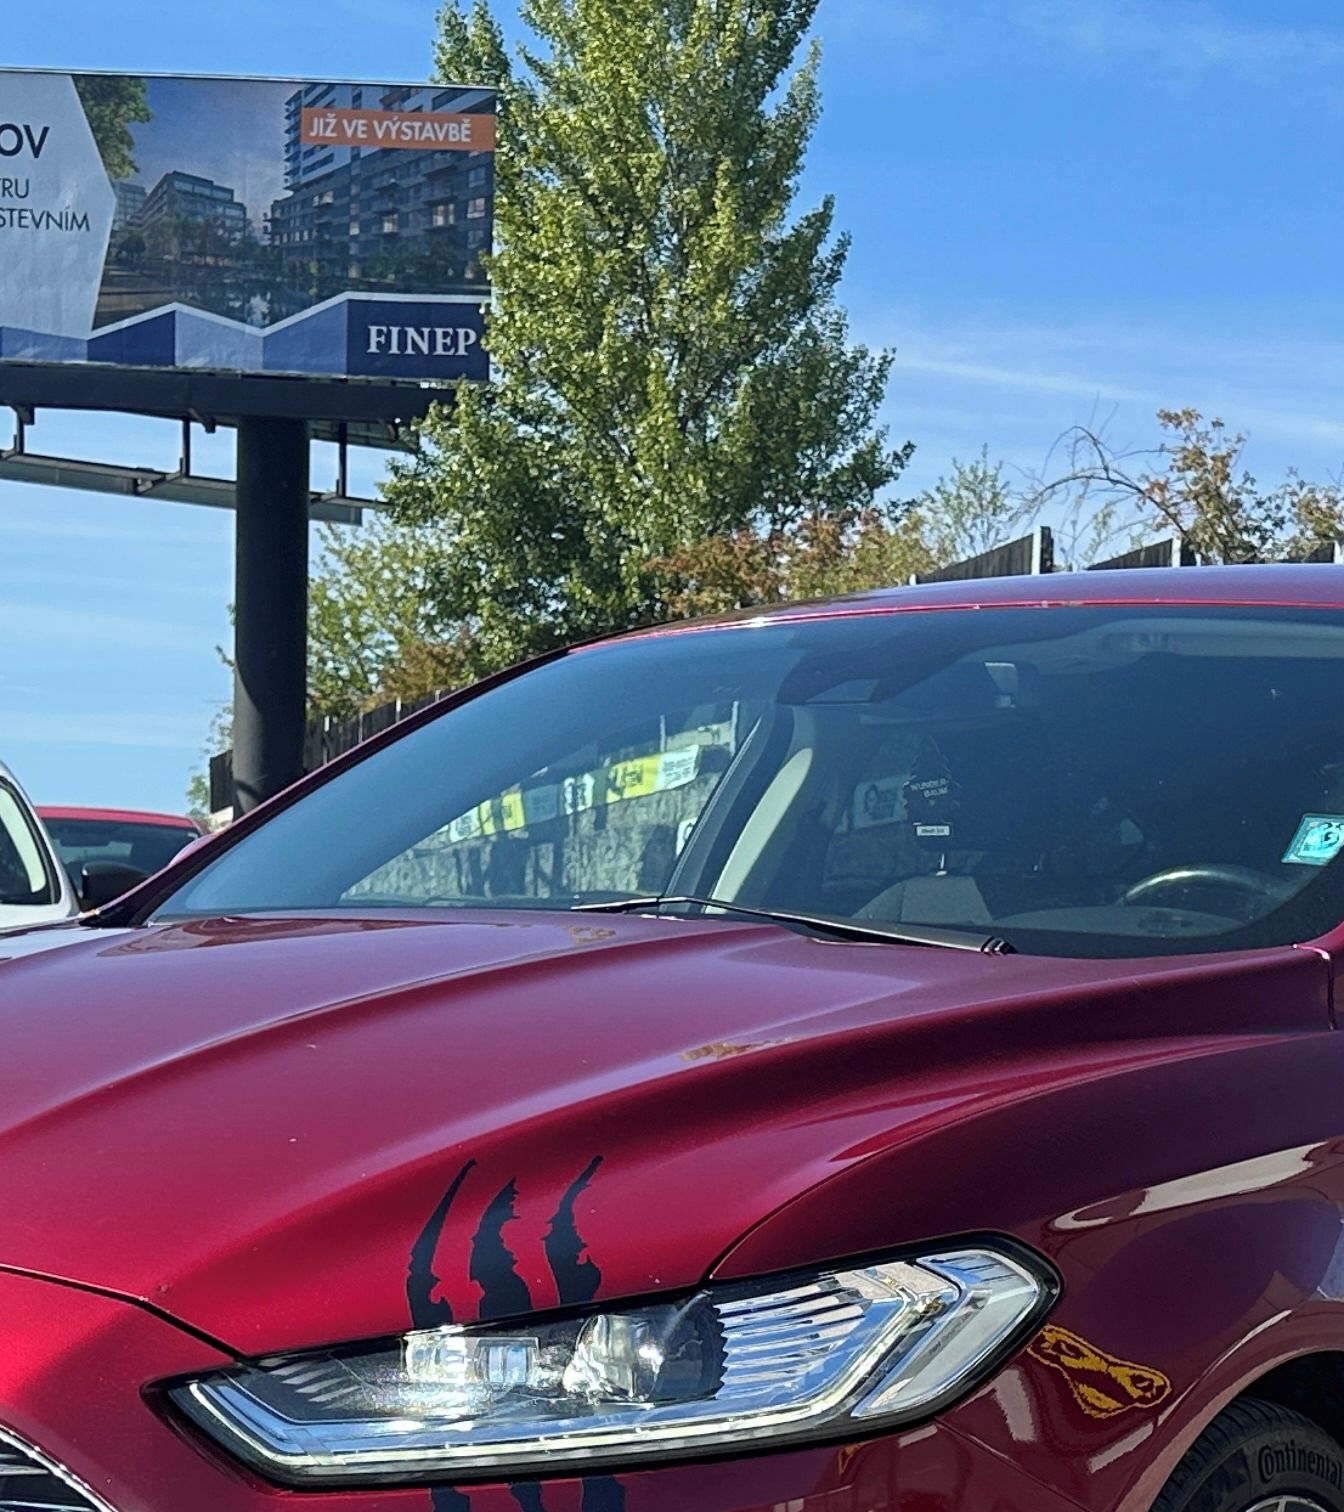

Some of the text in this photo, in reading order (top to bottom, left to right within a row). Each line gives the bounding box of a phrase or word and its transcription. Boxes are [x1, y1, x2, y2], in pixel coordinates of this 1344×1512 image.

[309, 113, 472, 142] JIŽ VE VÝSTAVBĚ
[366, 325, 477, 356] FINEP
[1258, 1439, 1343, 1491] Continental
